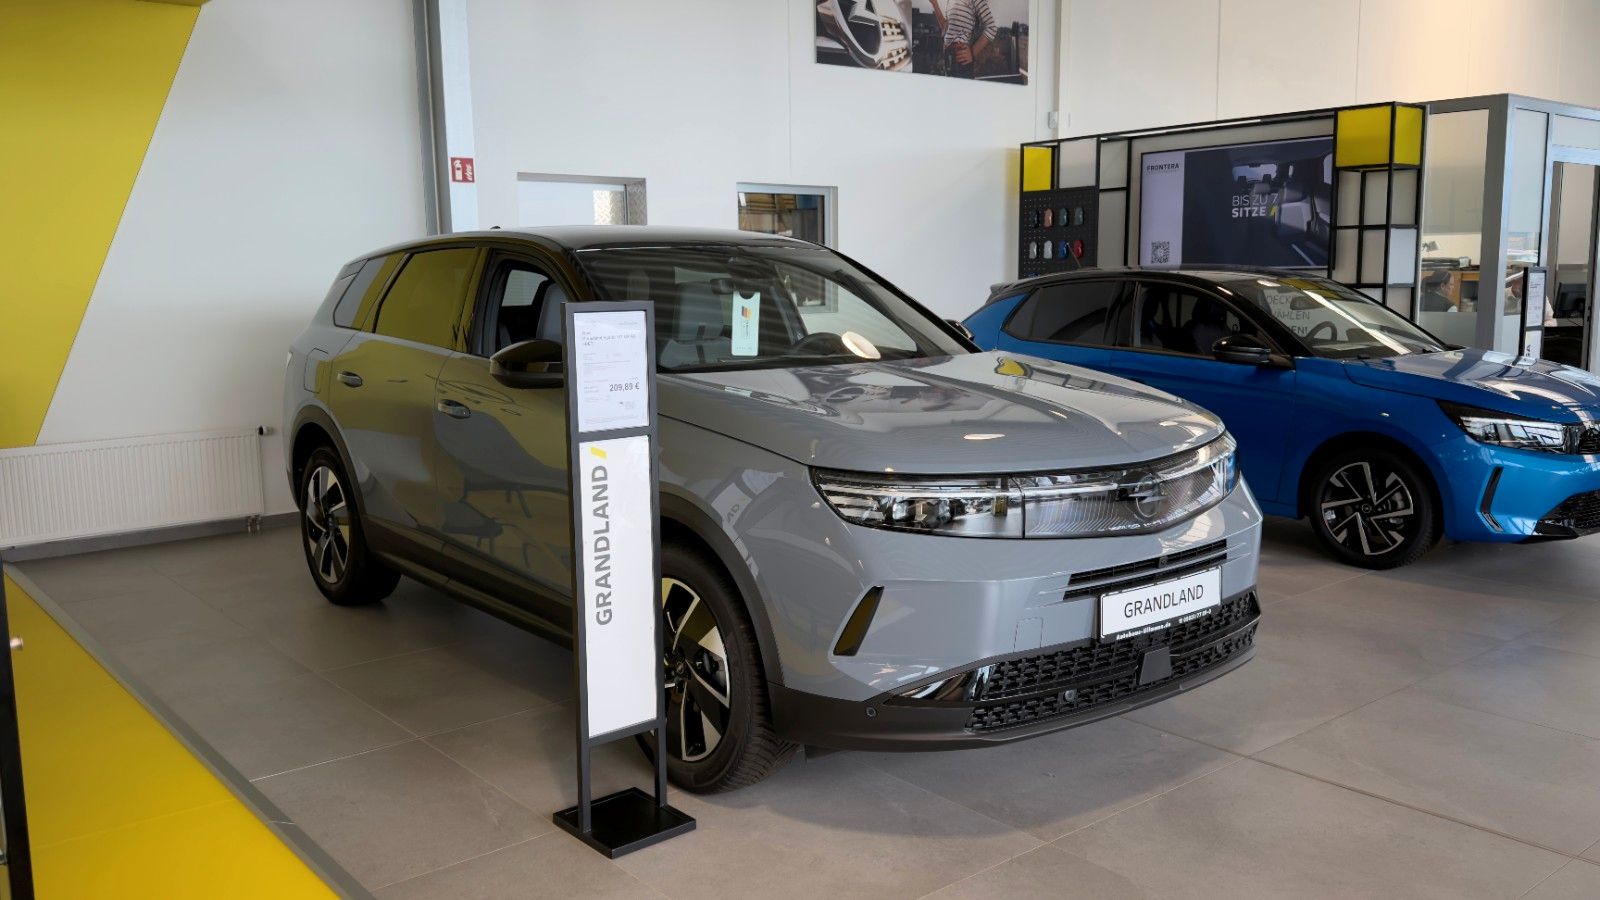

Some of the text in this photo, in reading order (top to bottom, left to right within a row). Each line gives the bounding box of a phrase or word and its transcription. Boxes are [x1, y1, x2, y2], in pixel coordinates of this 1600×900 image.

[1146, 163, 1179, 171] FRONTERA
[1231, 193, 1279, 207] BIS ZU 7
[1231, 206, 1266, 218] SITZE
[591, 465, 612, 625] GRANDLAND
[1124, 584, 1204, 618] GRANDLAND
